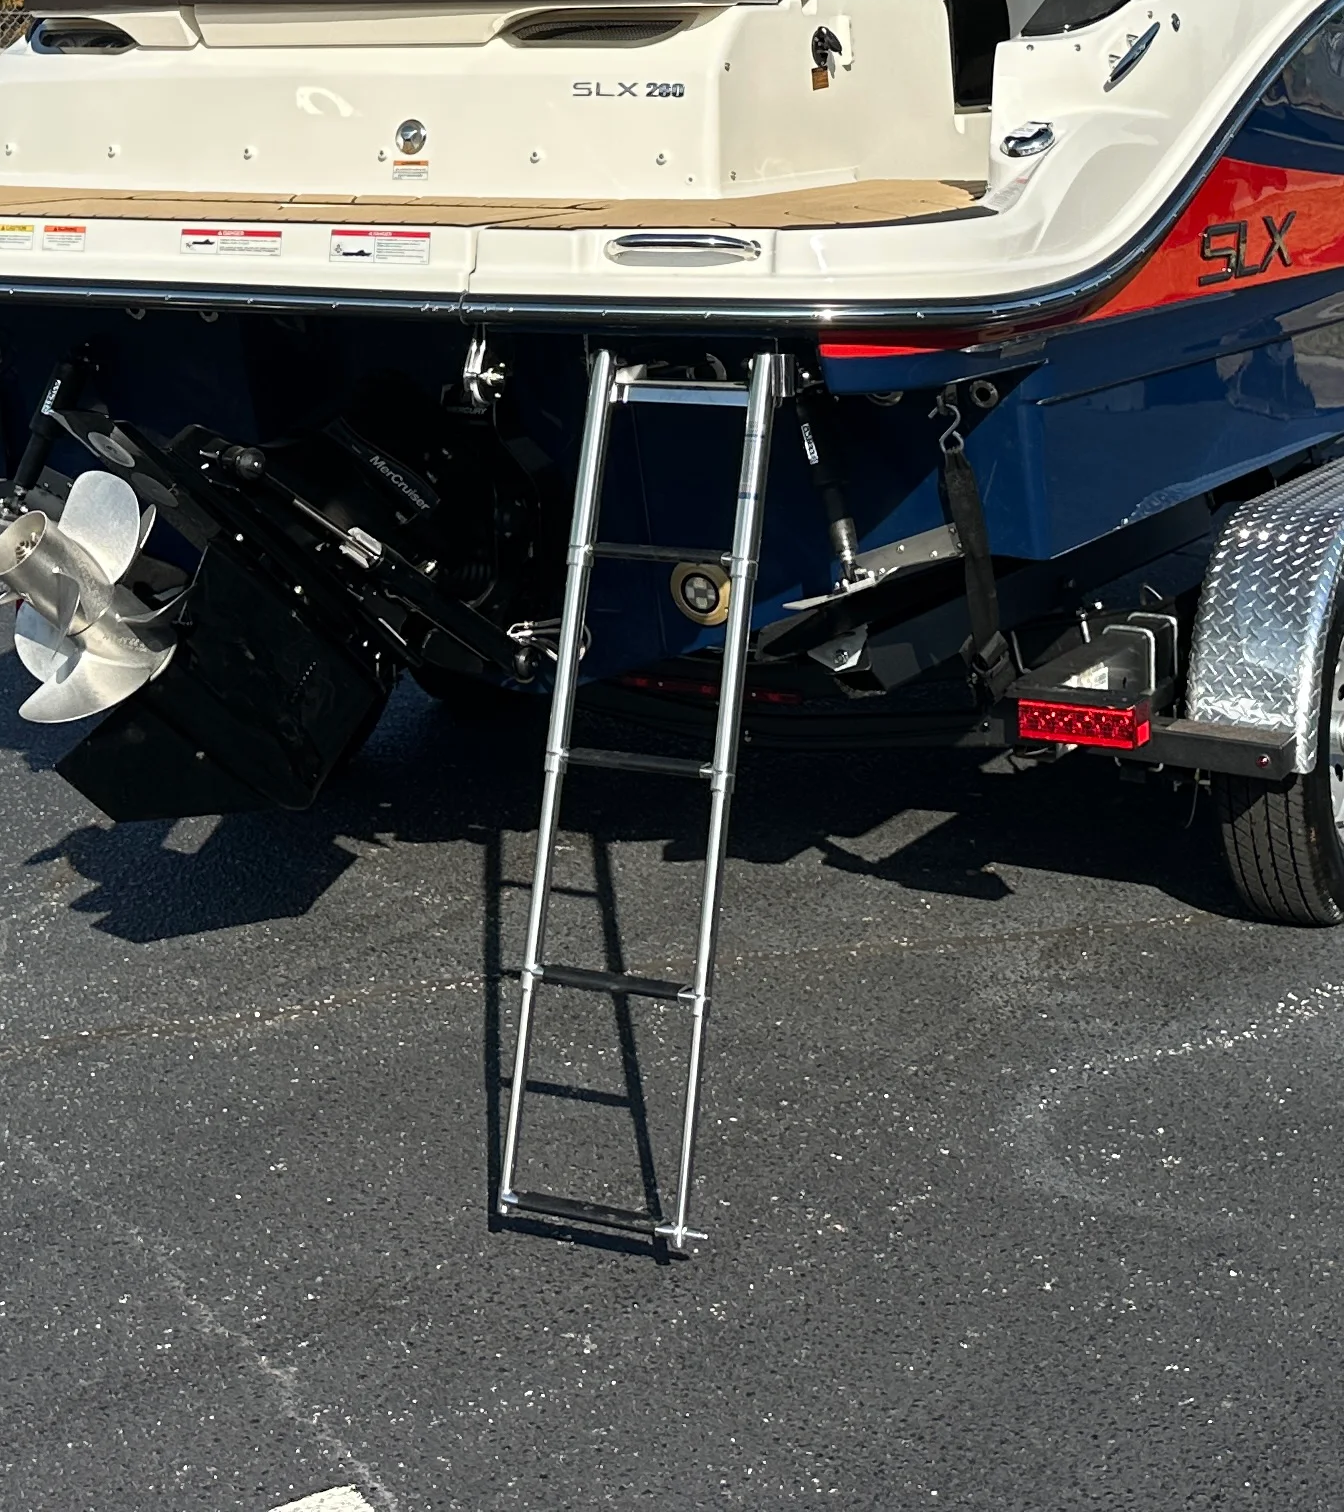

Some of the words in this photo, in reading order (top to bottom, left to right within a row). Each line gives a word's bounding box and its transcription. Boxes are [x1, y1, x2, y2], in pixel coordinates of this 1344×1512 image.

[572, 81, 639, 97] SLX
[1198, 210, 1297, 287] SLX
[369, 455, 430, 509] MerCruiser
